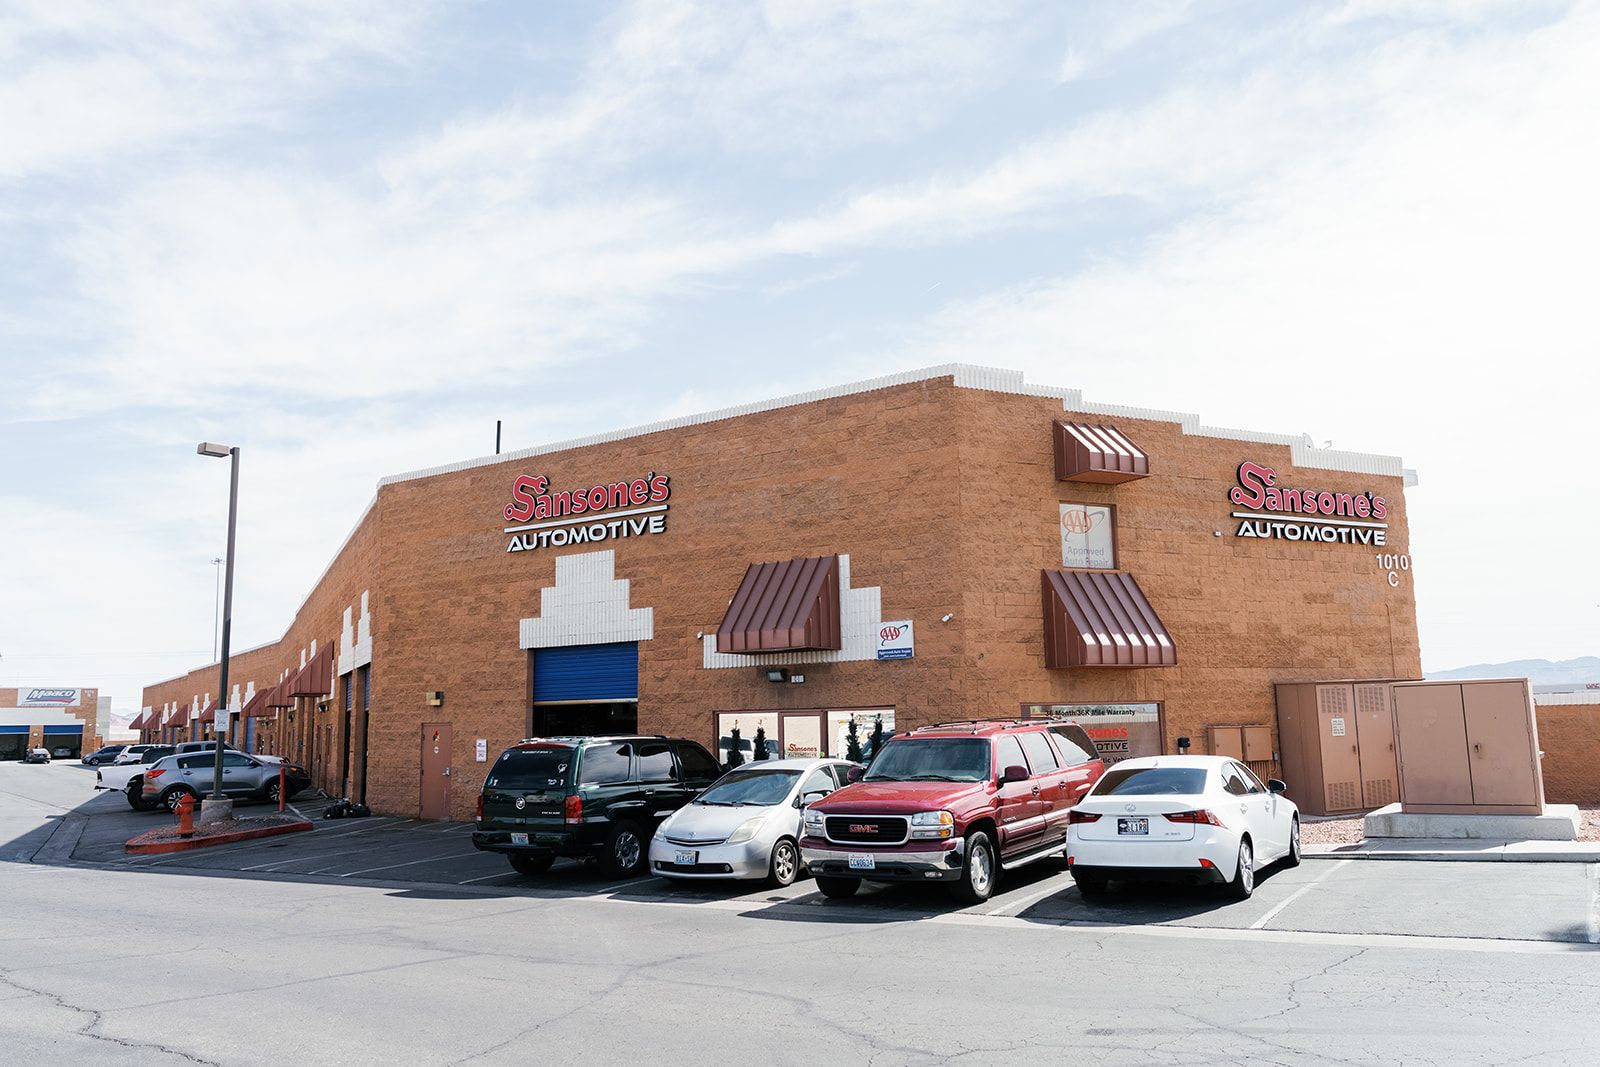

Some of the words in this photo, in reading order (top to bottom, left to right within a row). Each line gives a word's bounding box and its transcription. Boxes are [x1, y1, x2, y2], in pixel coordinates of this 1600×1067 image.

[503, 471, 670, 522] Sansone's
[1230, 461, 1388, 519] Sansone's
[506, 515, 666, 553] AUTOMOTIVE
[1237, 520, 1387, 546] AUTOMOTIVE
[1067, 546, 1104, 556] Approved
[1064, 556, 1085, 566] Auto
[1376, 553, 1409, 570] 1010
[1387, 571, 1399, 587] C
[880, 626, 900, 640] AAA
[1106, 708, 1135, 716] Warranty
[1087, 727, 1128, 739] sone's
[1096, 742, 1128, 750] OTIVE
[849, 824, 879, 833] GMC
